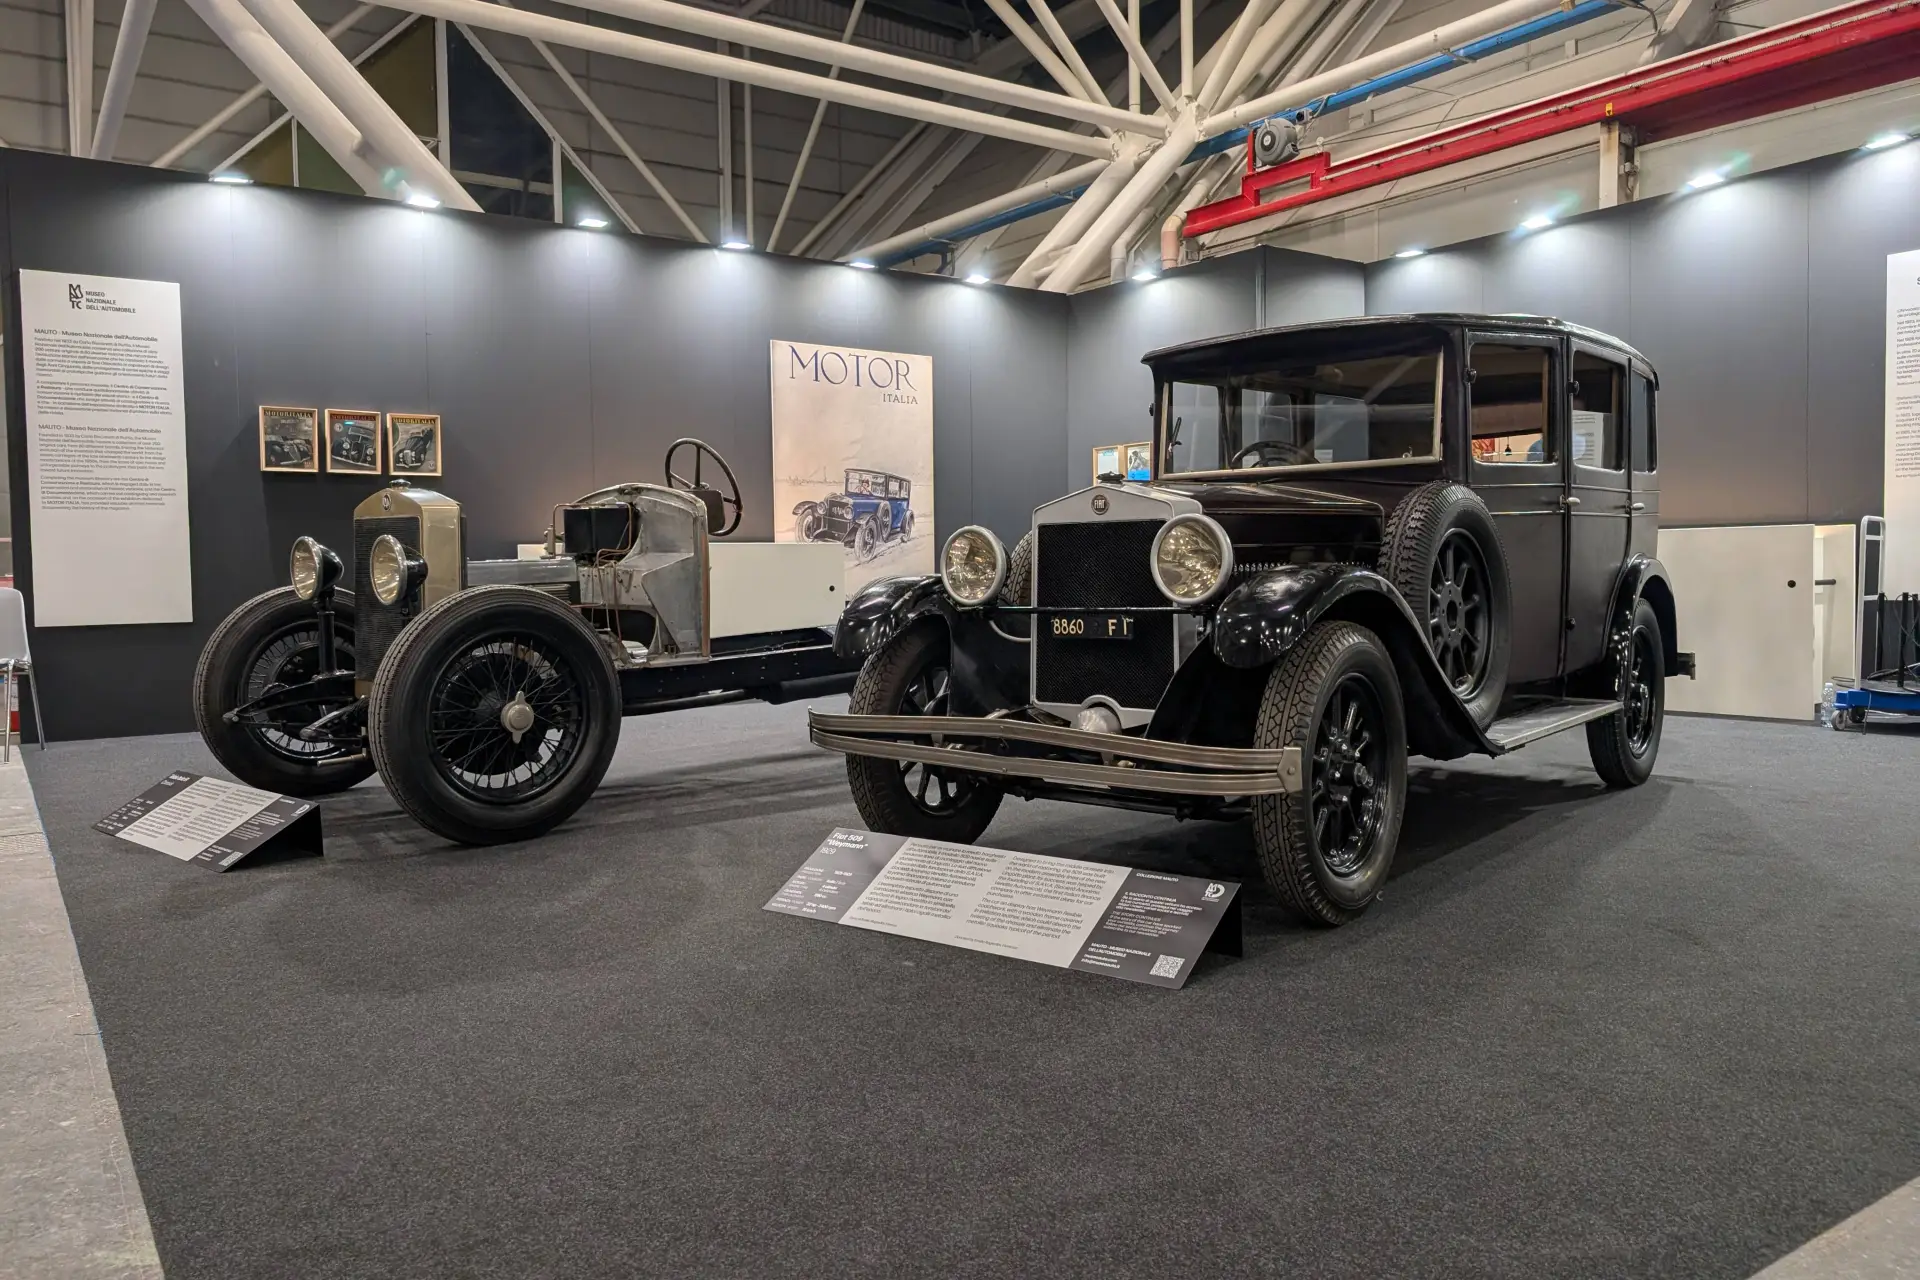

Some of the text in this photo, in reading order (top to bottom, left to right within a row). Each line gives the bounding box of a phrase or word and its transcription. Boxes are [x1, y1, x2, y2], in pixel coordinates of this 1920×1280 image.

[86, 305, 136, 313] DELL'AUTOMOBILE
[788, 344, 918, 392] MOTOR
[882, 394, 918, 404] ITALIA
[1094, 500, 1105, 509] FIAT
[1053, 618, 1084, 634] 8860
